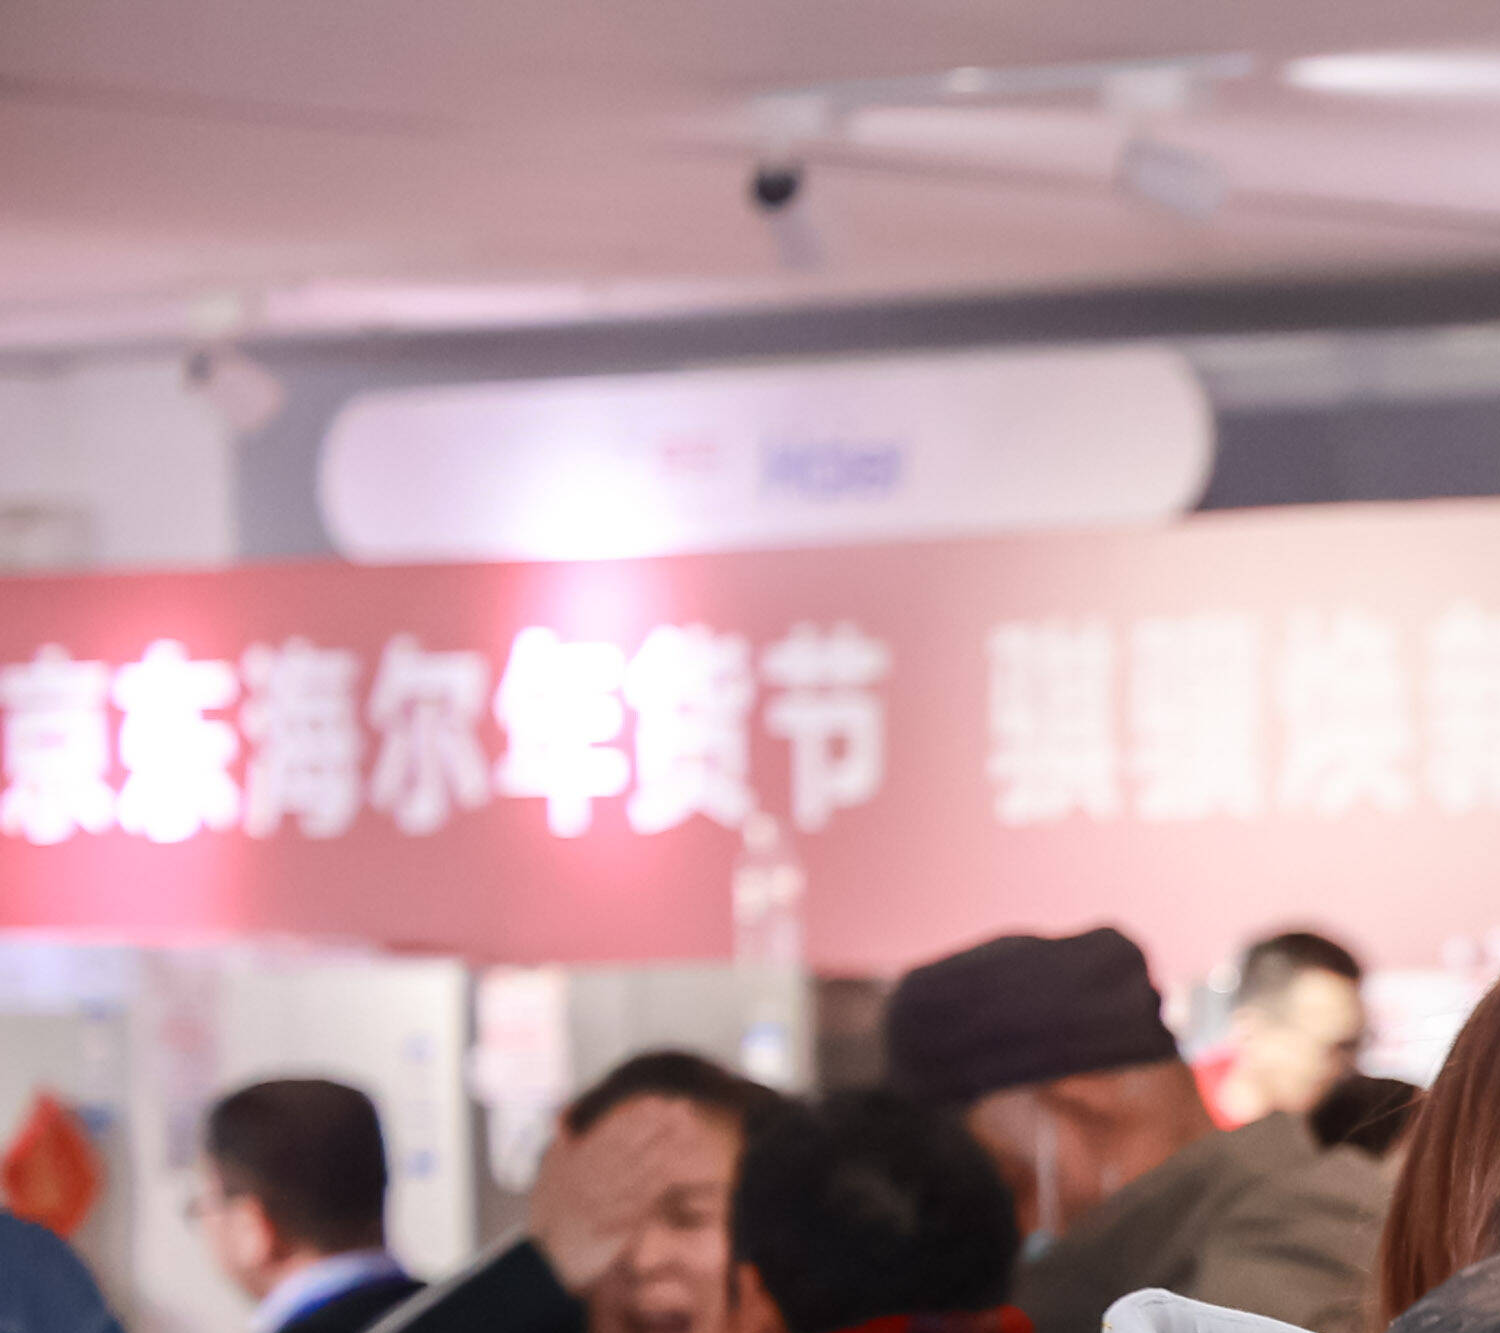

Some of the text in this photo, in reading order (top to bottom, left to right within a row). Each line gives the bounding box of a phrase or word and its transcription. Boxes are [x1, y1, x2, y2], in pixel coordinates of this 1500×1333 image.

[0, 620, 893, 845] 京东海尔年货节
